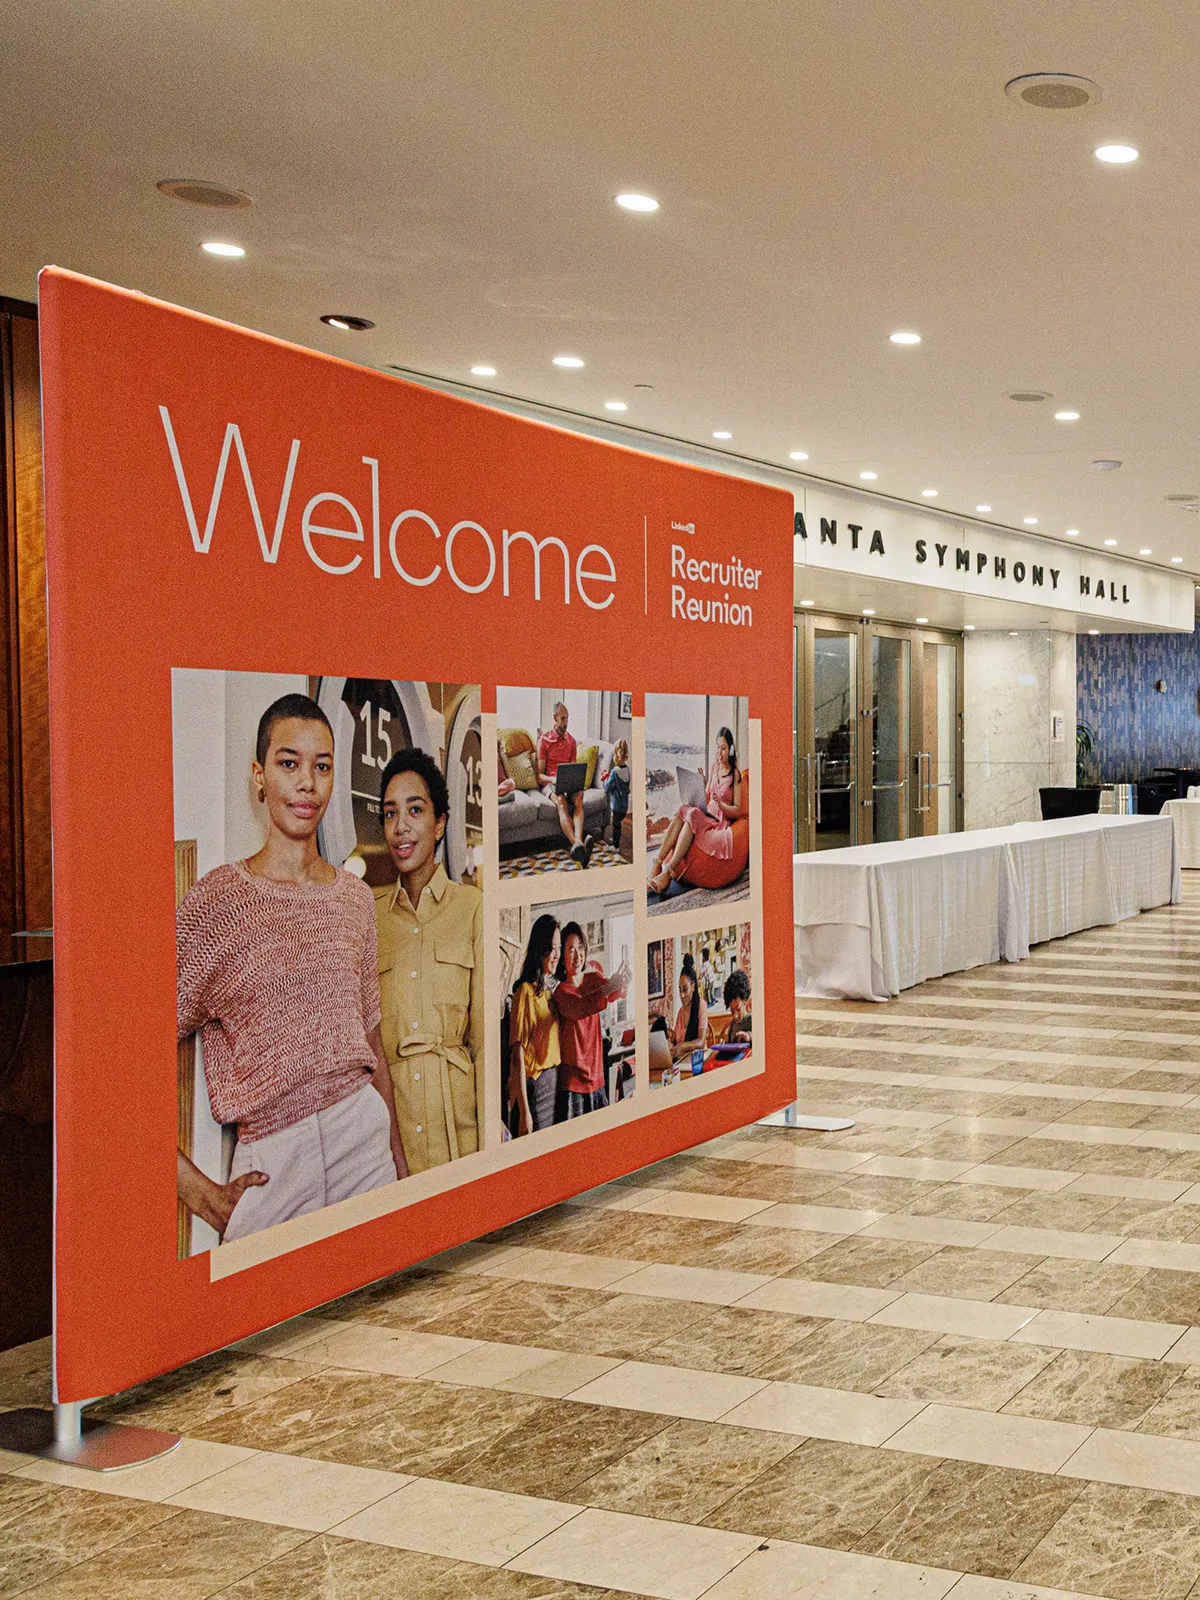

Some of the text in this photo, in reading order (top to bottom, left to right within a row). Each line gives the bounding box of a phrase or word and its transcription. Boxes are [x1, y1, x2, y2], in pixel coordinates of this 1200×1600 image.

[158, 405, 617, 610] Welcome
[671, 544, 762, 590] Recruiter
[915, 539, 1060, 589] SYMPHONY
[1079, 575, 1130, 604] HALL
[671, 584, 753, 627] Reunion
[360, 700, 393, 771] 15
